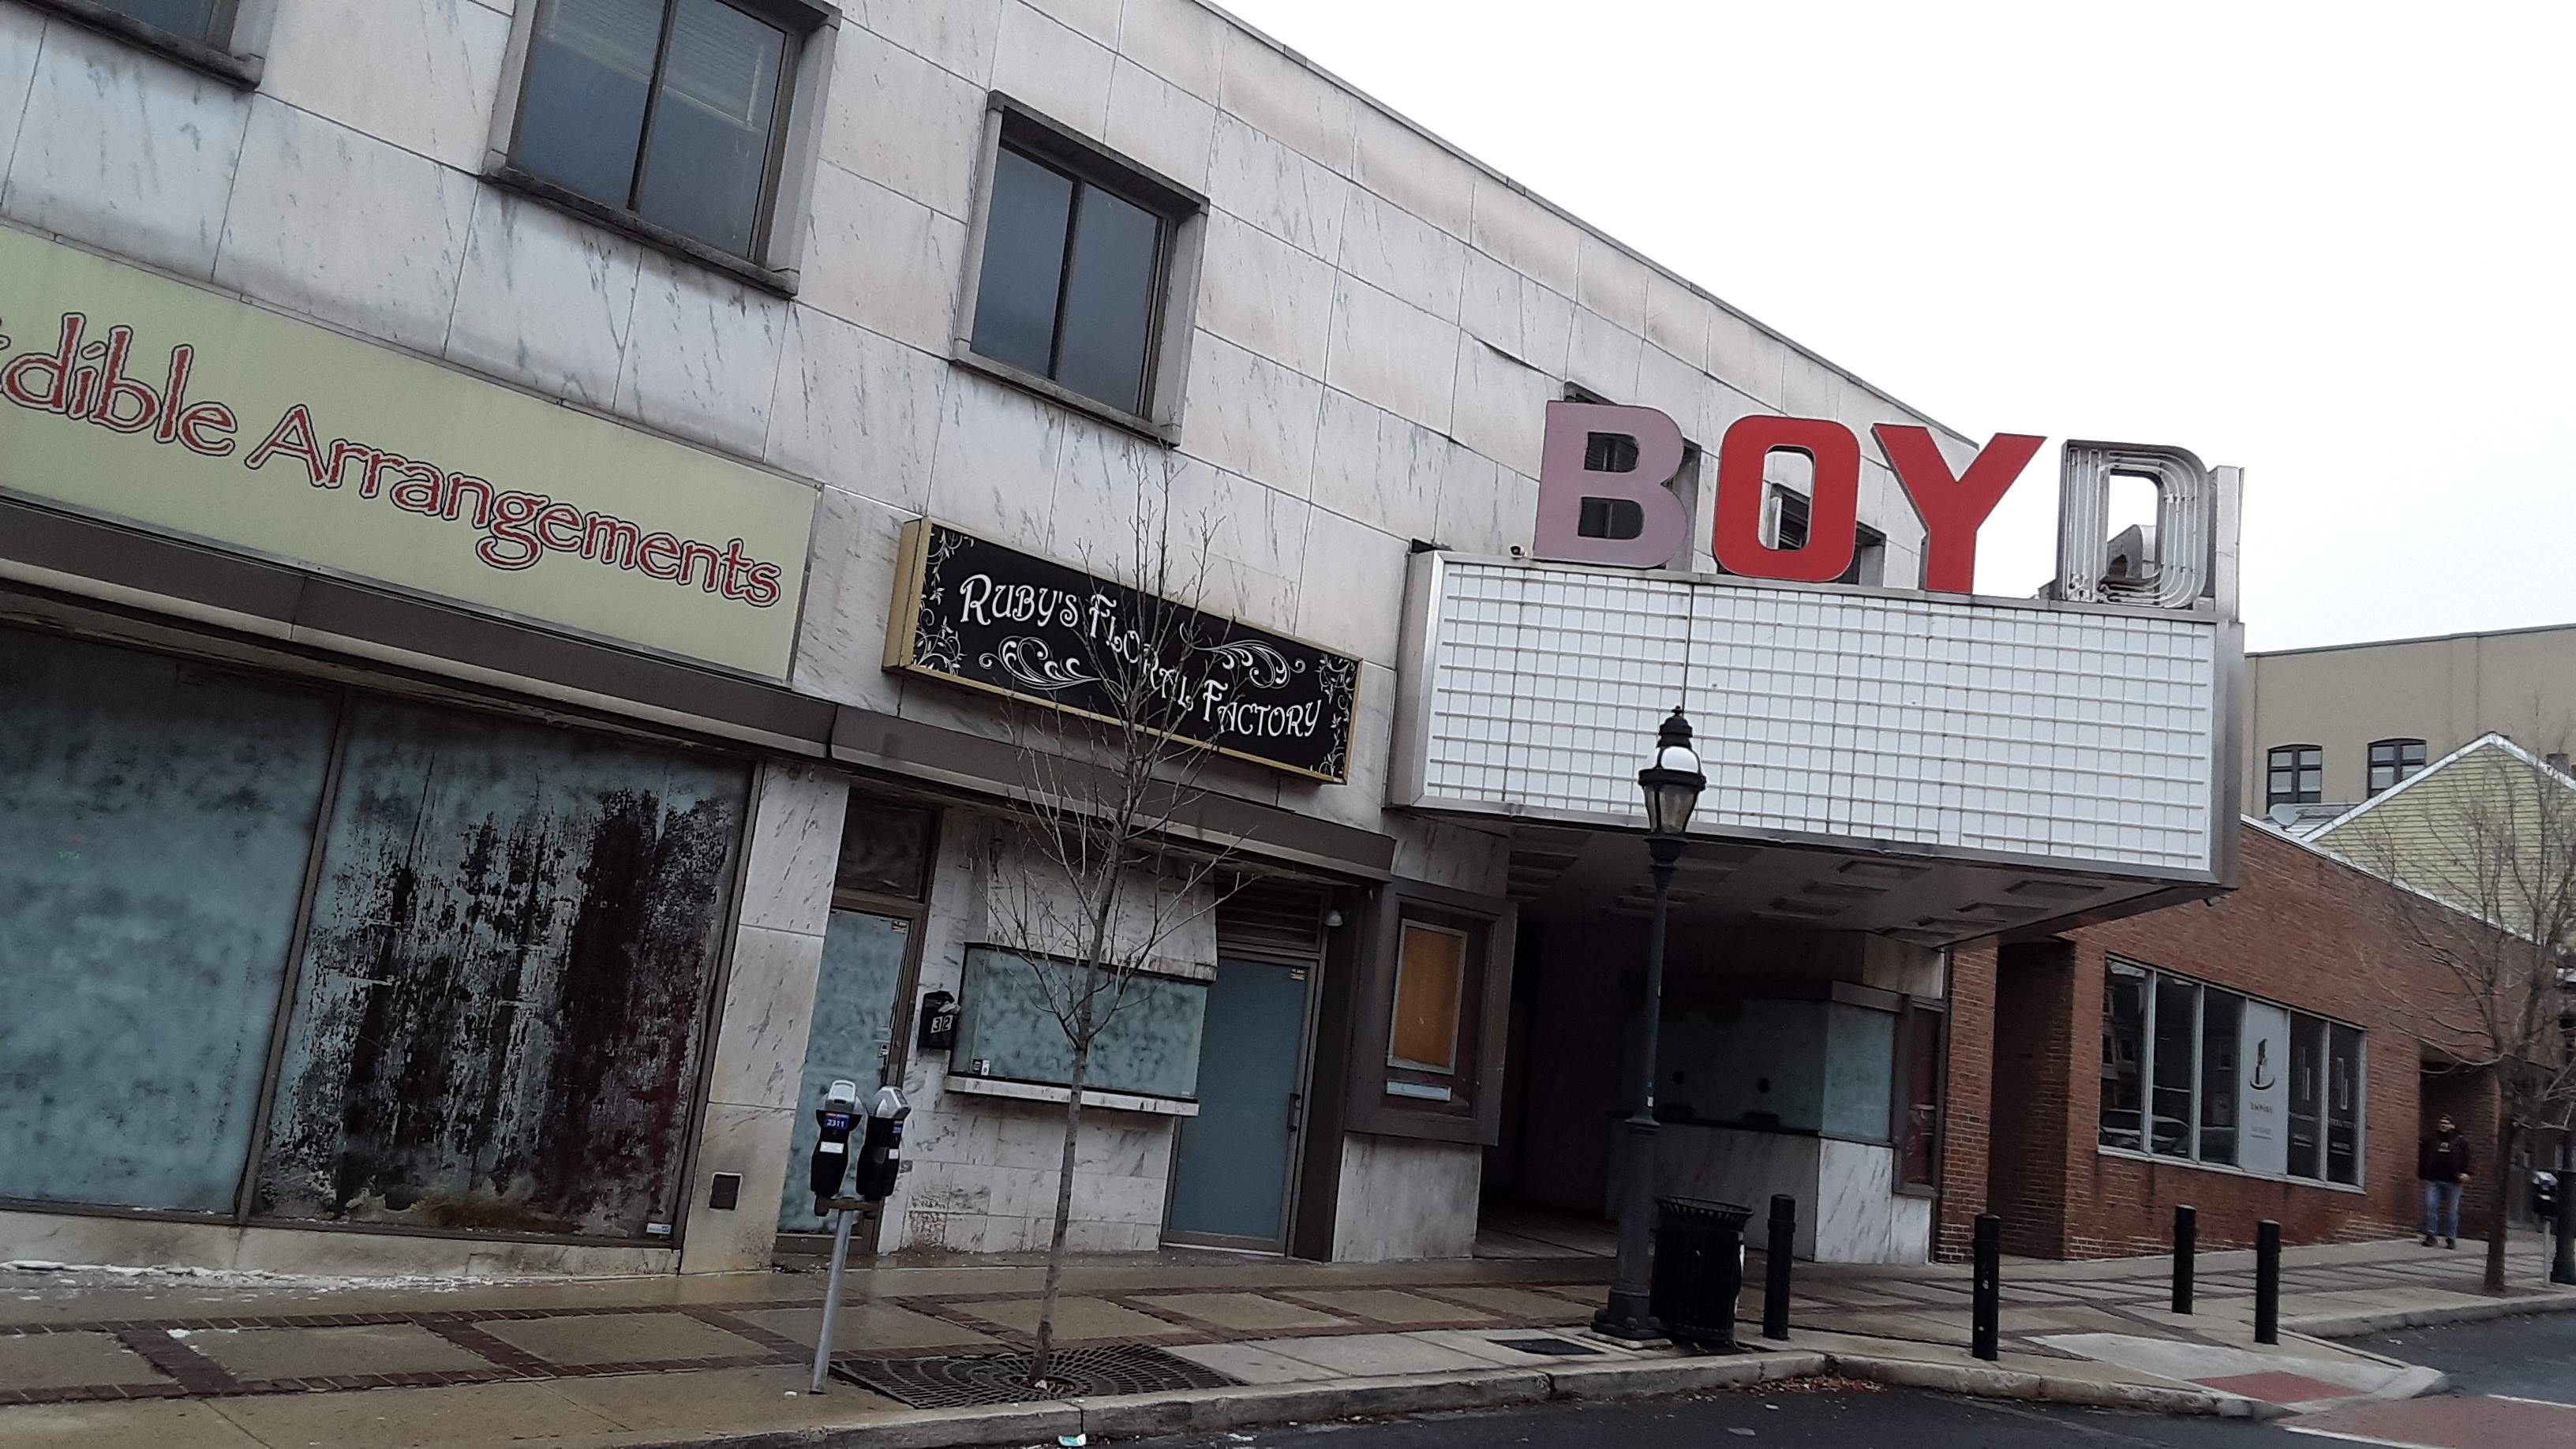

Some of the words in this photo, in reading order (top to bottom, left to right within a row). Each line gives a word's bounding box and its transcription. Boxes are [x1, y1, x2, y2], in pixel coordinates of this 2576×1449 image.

[0, 312, 238, 456] dible
[245, 404, 782, 608] Arrangements
[1531, 399, 2210, 609] BOYD
[959, 574, 1078, 627] RUBY'S
[1202, 679, 1322, 737] FACTORY
[933, 1017, 951, 1032] 32
